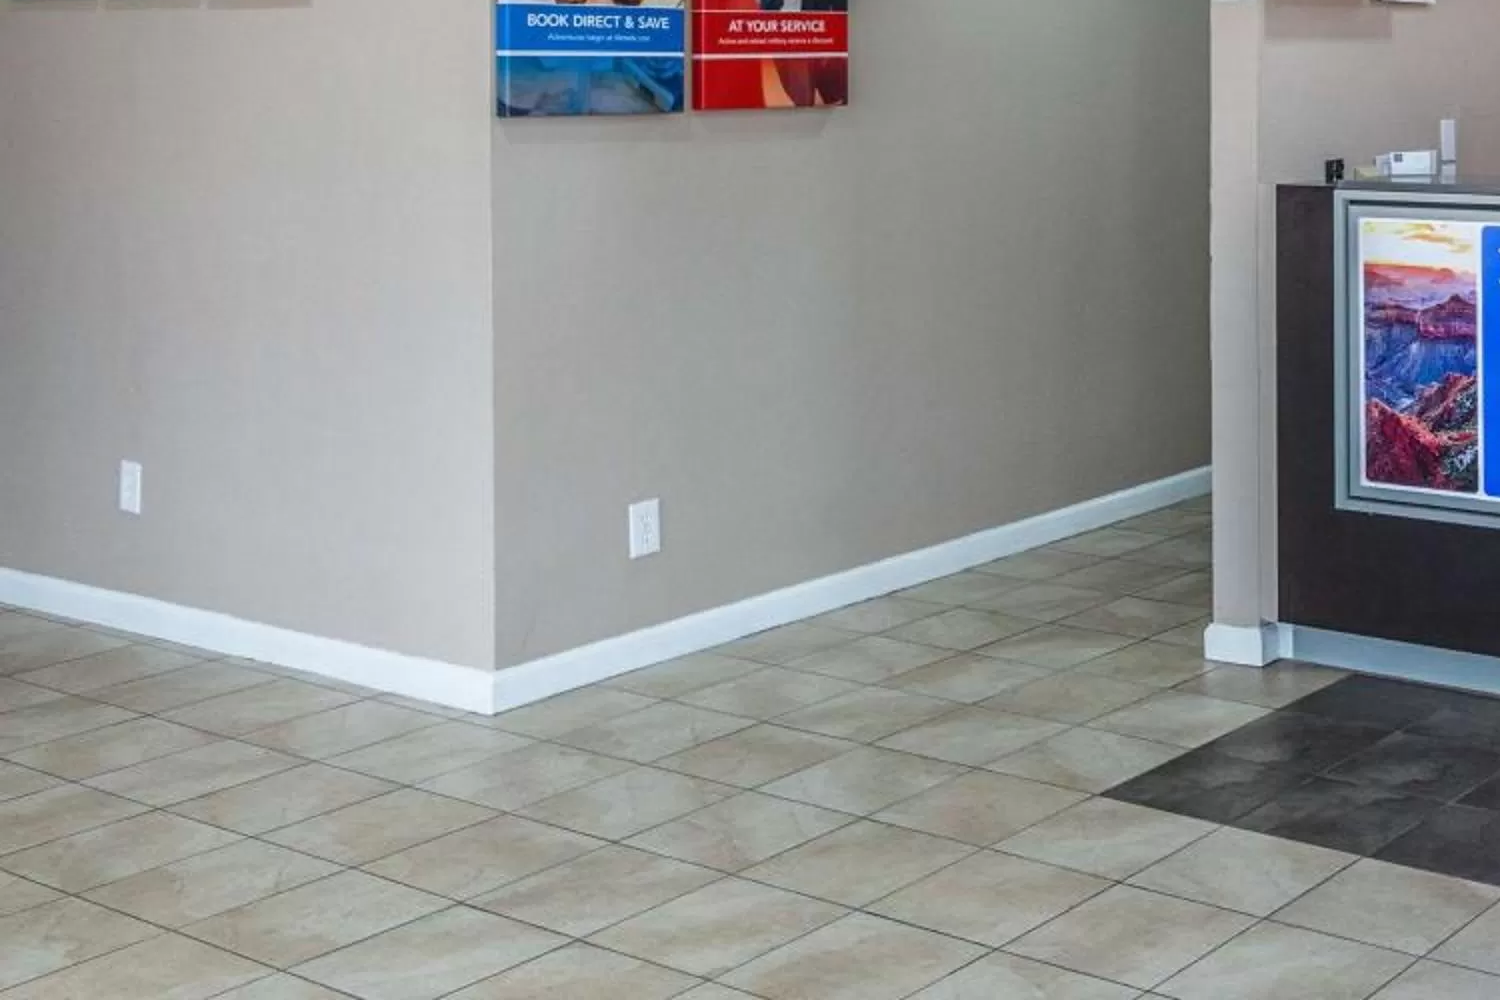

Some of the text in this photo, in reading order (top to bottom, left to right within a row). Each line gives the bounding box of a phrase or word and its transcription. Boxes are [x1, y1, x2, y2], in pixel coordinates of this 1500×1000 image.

[527, 13, 670, 29] BOOK DIRECT & SAVE
[729, 20, 826, 33] AT YOUR SERVICE
